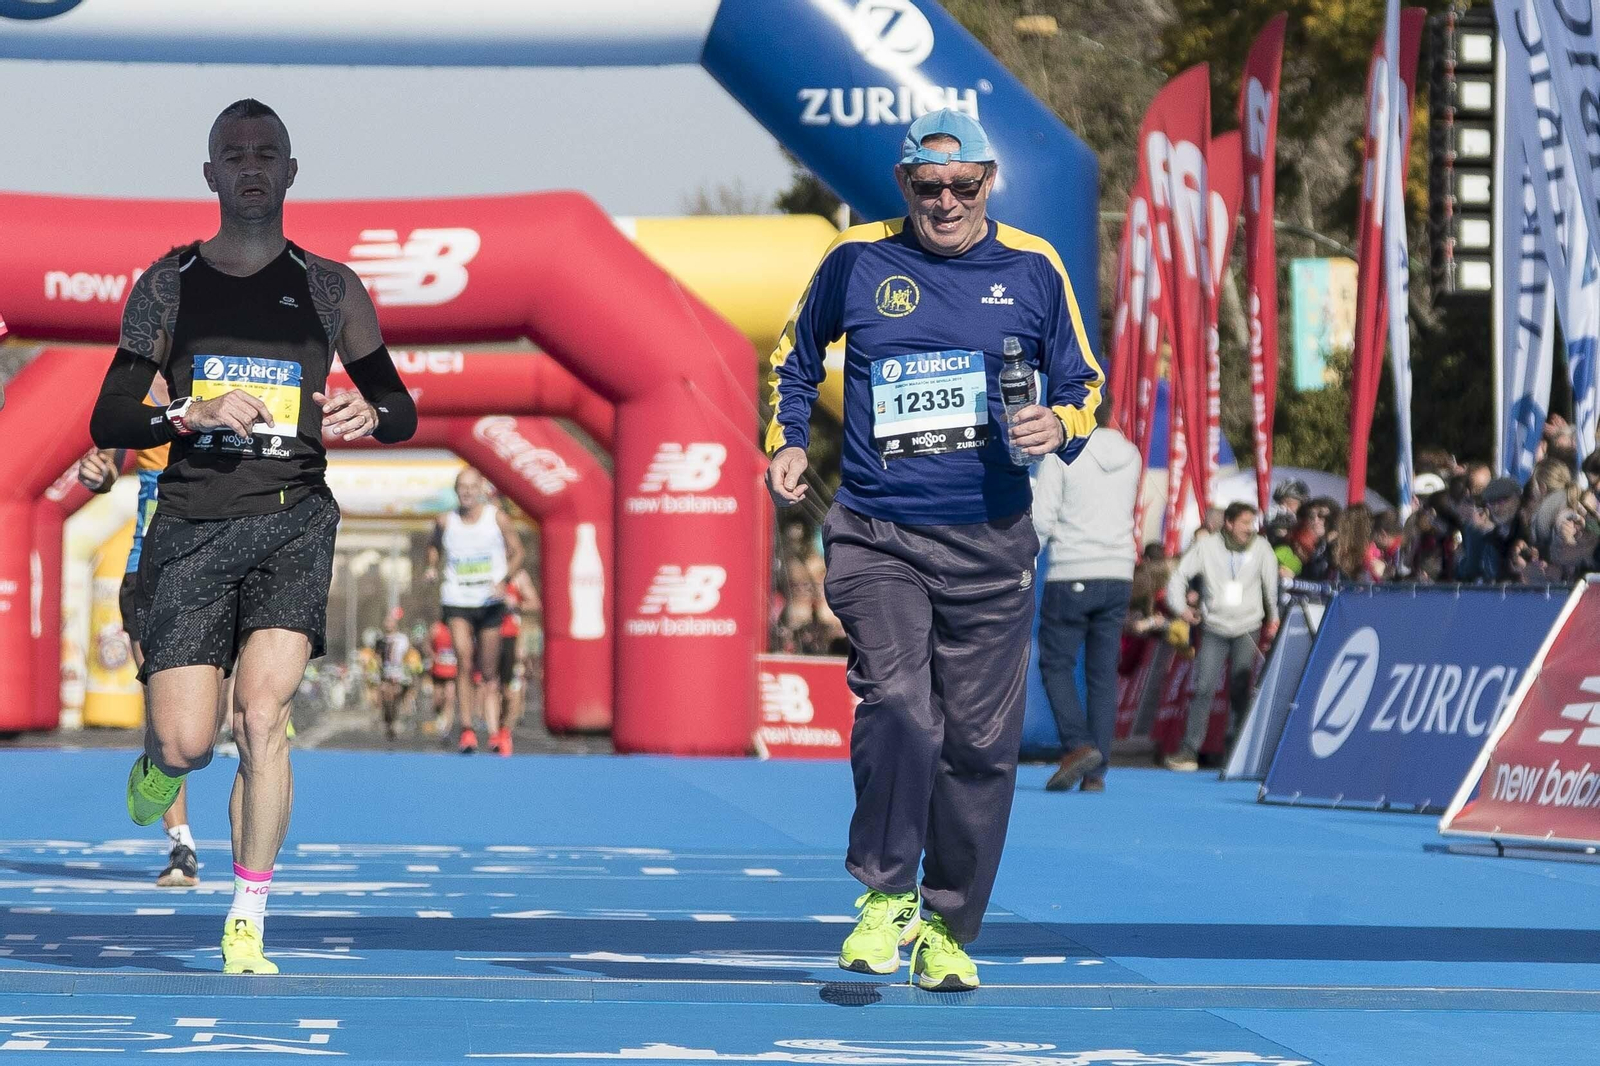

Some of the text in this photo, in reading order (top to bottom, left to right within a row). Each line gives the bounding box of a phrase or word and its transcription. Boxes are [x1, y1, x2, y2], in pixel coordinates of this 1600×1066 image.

[798, 86, 980, 127] ZURICH
[44, 270, 128, 303] new
[981, 297, 1014, 305] KELME
[228, 364, 288, 380] ZURICH
[905, 356, 970, 375] ZURICH
[894, 387, 965, 415] 12335
[956, 439, 985, 449] ZURICH
[626, 494, 738, 514] new balance
[626, 616, 737, 635] new balance
[1492, 763, 1544, 803] new
